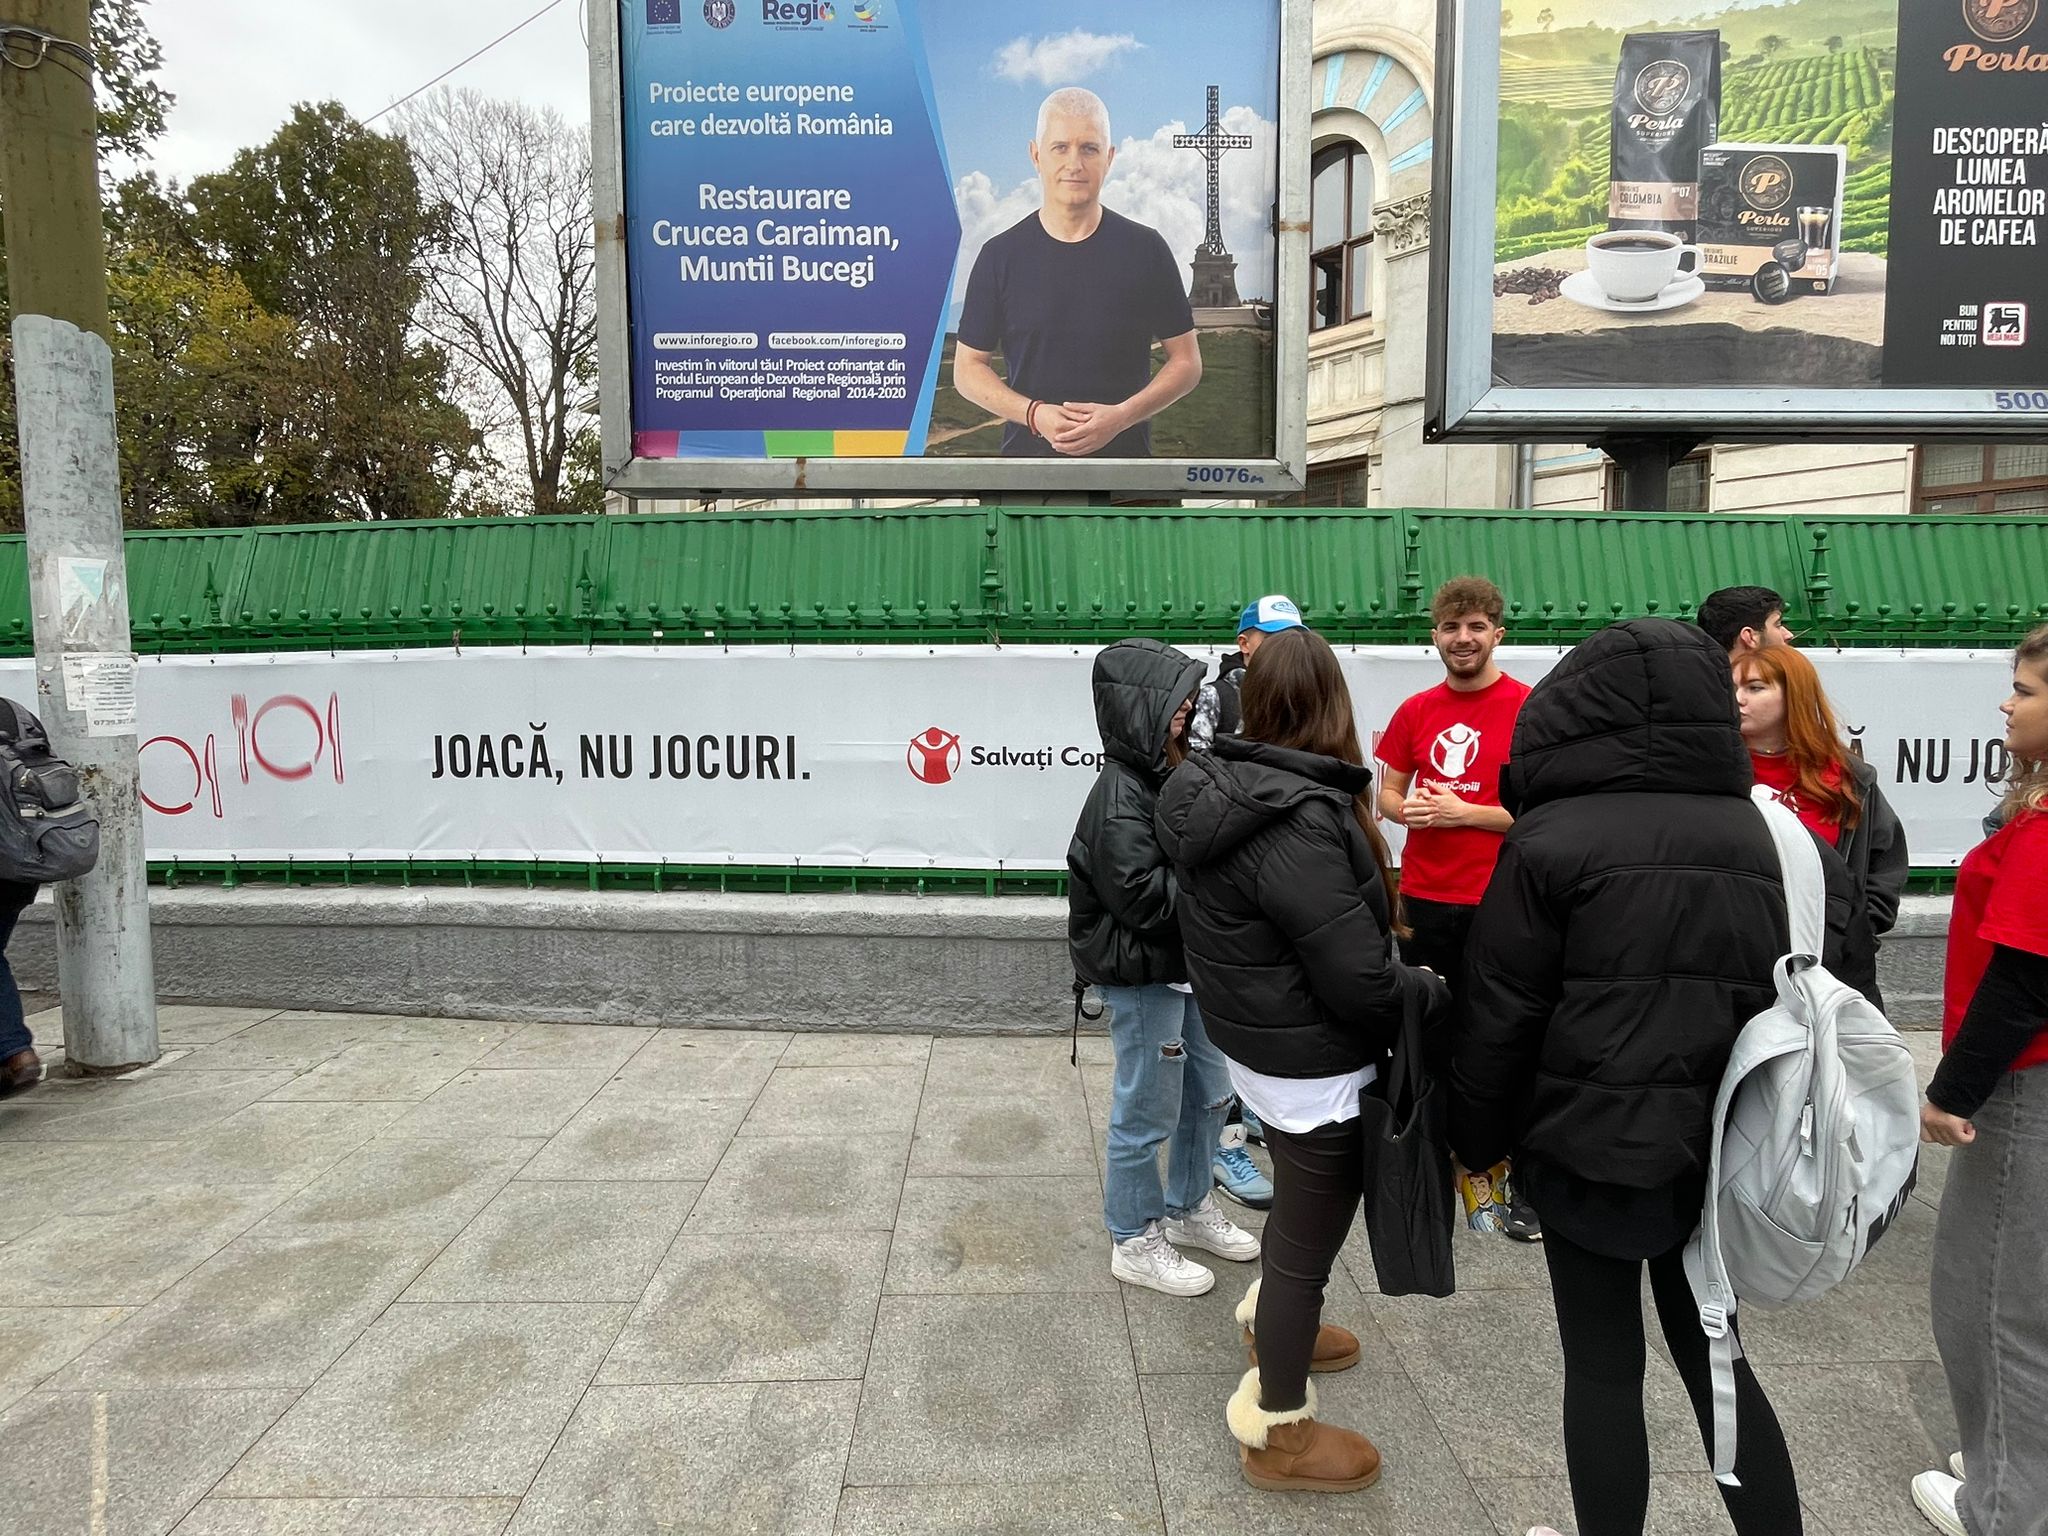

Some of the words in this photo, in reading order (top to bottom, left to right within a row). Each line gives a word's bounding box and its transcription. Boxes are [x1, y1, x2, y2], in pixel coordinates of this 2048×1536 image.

[1943, 44, 2048, 72] Perla
[650, 81, 739, 103] Proiecte
[746, 83, 854, 106] europene
[650, 116, 695, 136] care
[701, 112, 791, 136] dezvoltă
[797, 112, 893, 135] România
[1627, 114, 1684, 131] Perla
[1956, 158, 2027, 186] LUMEA
[700, 184, 851, 210] Restaurare
[1620, 192, 1662, 205] COLOMBIA
[1932, 188, 2046, 216] AROMELOR
[1737, 210, 1791, 226] Perla
[652, 219, 749, 246] Crucea
[756, 218, 899, 251] Caraiman,
[1939, 218, 1967, 245] DE
[1971, 218, 2037, 246] CAFEA
[680, 255, 773, 282] Muntii
[782, 255, 874, 288] Bucegi
[1959, 305, 1978, 317] BUN
[1943, 319, 1977, 331] PENTRU
[659, 333, 753, 347] www.inforegio.ro
[771, 335, 903, 347] facebook.com/inforegio.ro
[1940, 334, 1956, 346] NOI
[655, 358, 703, 371] Investim
[704, 358, 716, 371] în
[719, 358, 757, 371] viitorul
[760, 358, 783, 371] tău!
[786, 358, 825, 371] Proiect
[887, 359, 905, 371] din
[655, 372, 694, 385] Fondul
[695, 372, 748, 387] European
[750, 372, 765, 385] de
[767, 372, 825, 385] Dezvoltare
[827, 373, 881, 388] Regională
[883, 373, 905, 387] prin
[656, 386, 713, 400] Programul
[793, 386, 840, 400] Regional
[847, 387, 906, 399] 2014-2020
[1995, 392, 2048, 410] 500
[432, 721, 564, 785] JOACĂ,
[579, 734, 633, 779] NU
[649, 734, 811, 780] JOCURI.
[1060, 746, 1105, 772] Cop
[1896, 738, 1951, 784] NU
[1963, 738, 2008, 784] JO
